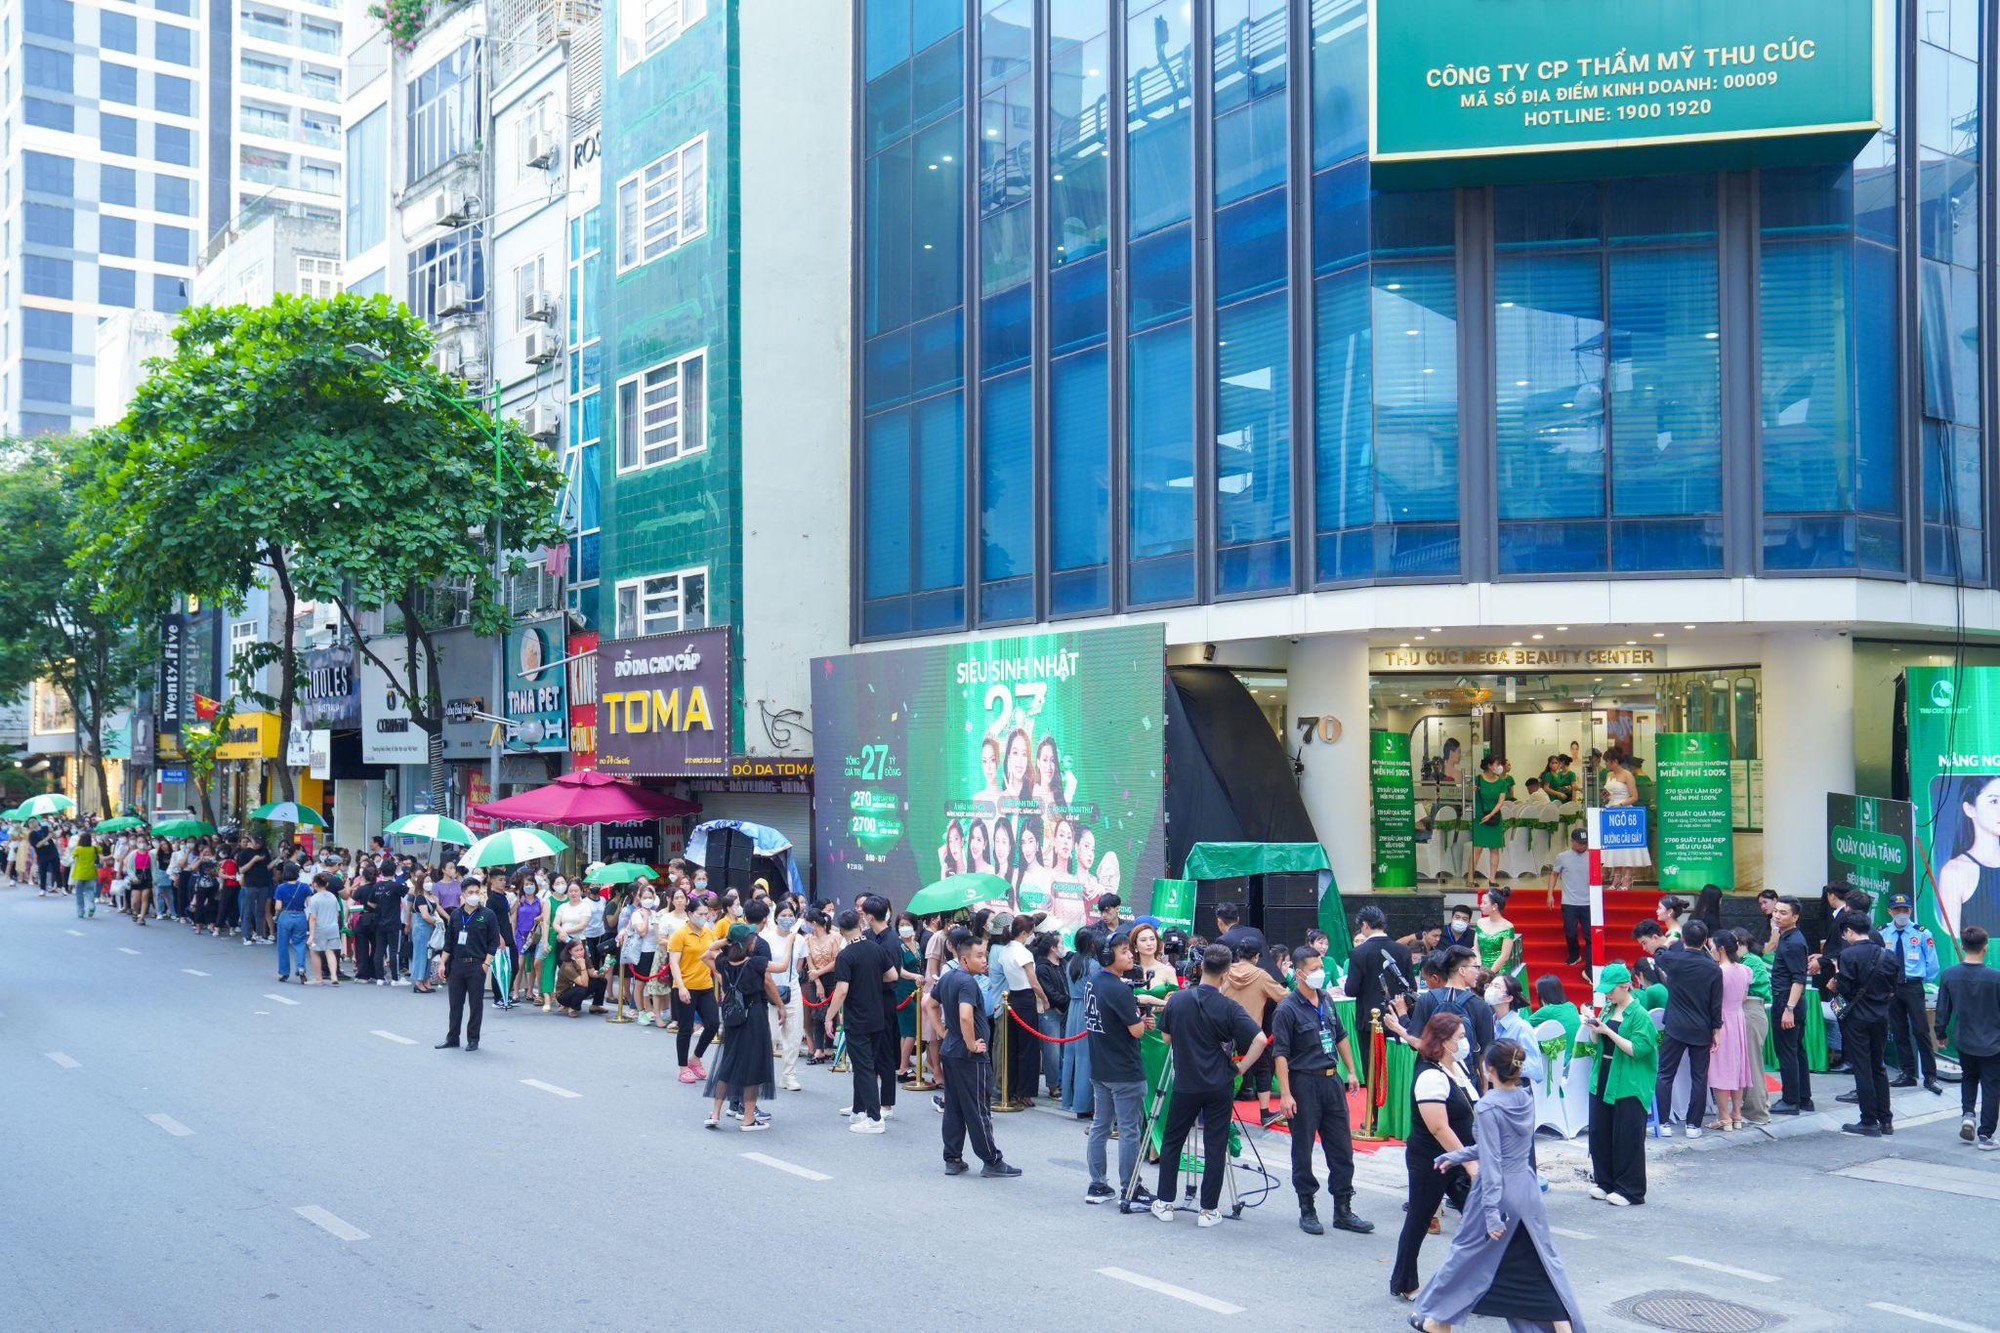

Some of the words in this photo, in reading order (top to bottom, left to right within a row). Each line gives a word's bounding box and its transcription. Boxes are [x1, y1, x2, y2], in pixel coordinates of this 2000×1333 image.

[1426, 63, 1490, 88] CÔNG
[1498, 63, 1530, 83] TY
[1537, 60, 1569, 80] CP
[1577, 47, 1649, 77] THẨM
[1657, 45, 1696, 71] MỸ
[1704, 45, 1756, 67] THU
[1763, 36, 1816, 62] CÚC
[1460, 90, 1489, 108] MÃ
[1494, 86, 1517, 106] SỐ
[1522, 90, 1551, 107] ĐỊA
[1556, 81, 1598, 101] ĐIỂM
[1603, 82, 1645, 98] KINH
[1649, 77, 1718, 95] DOANH:
[1723, 71, 1778, 89] 00009
[1524, 107, 1611, 127] HOTLINE:
[1616, 103, 1661, 120] 1900
[1667, 99, 1712, 117] 1920
[615, 649, 632, 677] ĐỒ
[632, 658, 649, 676] DA
[649, 655, 674, 673] CAO
[674, 644, 701, 671] CẤP
[957, 656, 988, 684] SIÊU
[990, 658, 1029, 681] SINH
[1033, 648, 1079, 682] NHẬT
[1386, 651, 1419, 665] THU
[1463, 650, 1510, 664] MEGA
[1515, 650, 1582, 664] BEAUTY
[1586, 649, 1654, 664] CENTER
[538, 686, 559, 711] PET
[602, 686, 714, 734] TOMA
[1297, 716, 1342, 744] 70
[732, 759, 752, 776] ĐỒ
[755, 764, 774, 775] DA
[861, 745, 888, 780] 27
[1703, 769, 1726, 777] 100%
[1609, 811, 1626, 826] NGÕ
[1628, 814, 1637, 826] 68
[607, 834, 653, 849] TRÀNG
[1859, 841, 1877, 858] QUÀ
[1877, 843, 1901, 864] TẶNG
